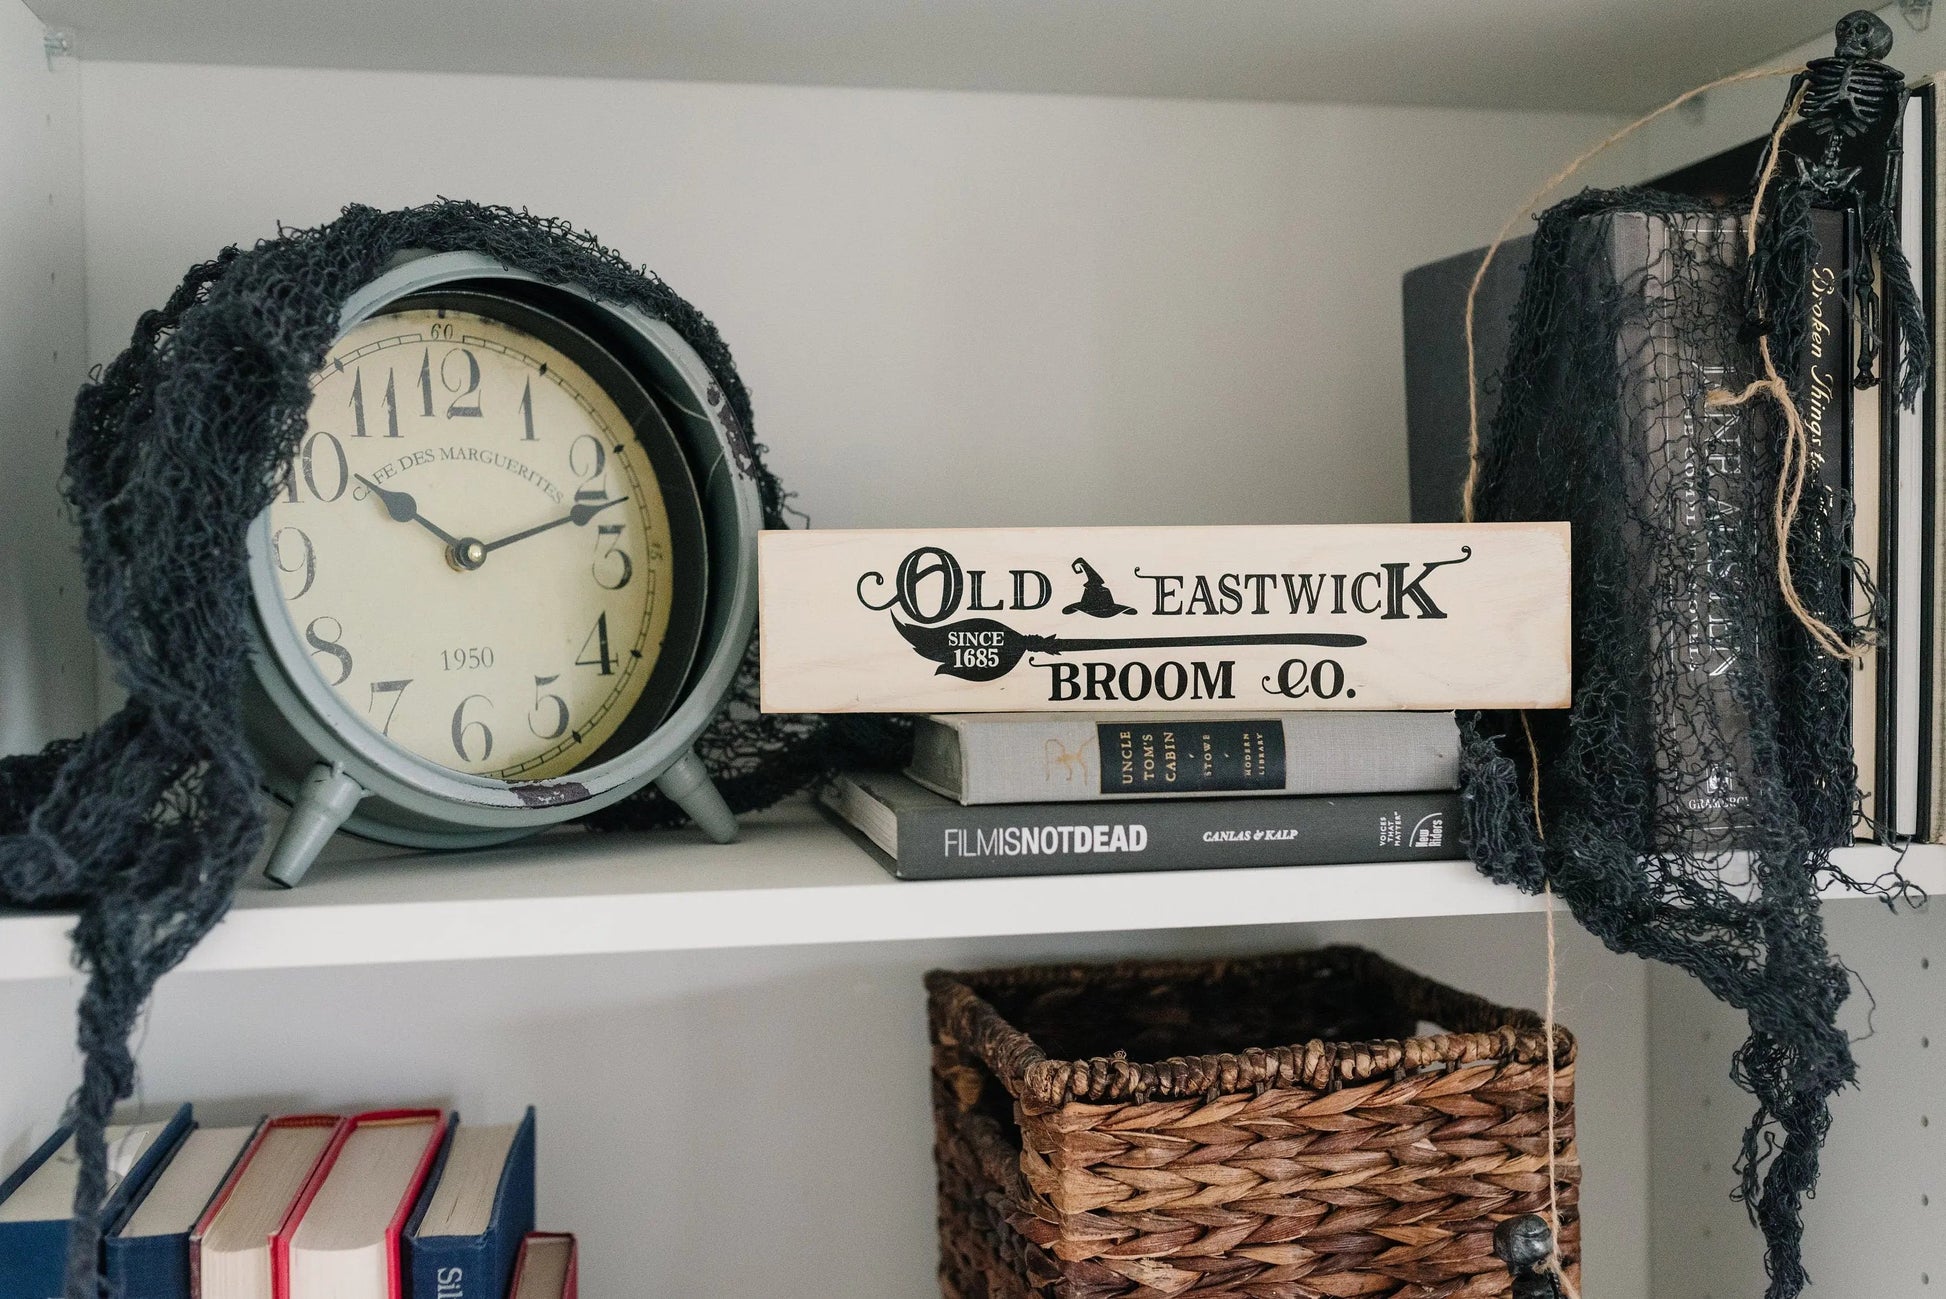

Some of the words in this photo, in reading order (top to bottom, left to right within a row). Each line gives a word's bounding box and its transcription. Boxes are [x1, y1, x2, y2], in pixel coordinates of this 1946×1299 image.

[430, 322, 454, 341] 60
[1811, 264, 1836, 359] Broken
[349, 365, 405, 438] 11
[417, 346, 484, 420] 12
[518, 374, 541, 442] 1
[1804, 364, 1835, 447] Things
[1691, 361, 1742, 475] JNE
[281, 430, 349, 504] 10
[352, 463, 398, 502] CFE
[399, 448, 436, 472] DES
[438, 446, 565, 505] MARGUERITES
[568, 433, 609, 503] 2
[271, 526, 317, 601] 9
[591, 523, 633, 591] 3
[857, 546, 1053, 624] OLD
[1134, 545, 1472, 620] EASTWICK
[304, 615, 354, 687] 8
[440, 646, 495, 672] 1950
[574, 610, 620, 676] 4
[947, 631, 1005, 647] SINCE
[952, 648, 1000, 668] 1685
[368, 678, 414, 737] 7
[527, 673, 570, 740] 5
[1028, 656, 1236, 702] BROOM
[1261, 658, 1357, 700] CO.
[450, 694, 494, 763] 6
[1120, 731, 1133, 784] UNCLE
[1142, 734, 1155, 781] TOM'S
[1163, 731, 1177, 782] CABIN
[1202, 734, 1213, 777] STOWE
[1243, 733, 1252, 777] MODERN
[1256, 732, 1265, 776] LIBRARY
[1202, 830, 1252, 842] CANLAS
[1253, 829, 1265, 841] &
[1264, 829, 1299, 841] KALP
[1387, 820, 1395, 843] THAT
[1415, 829, 1429, 848] New
[1428, 819, 1443, 847] Riders
